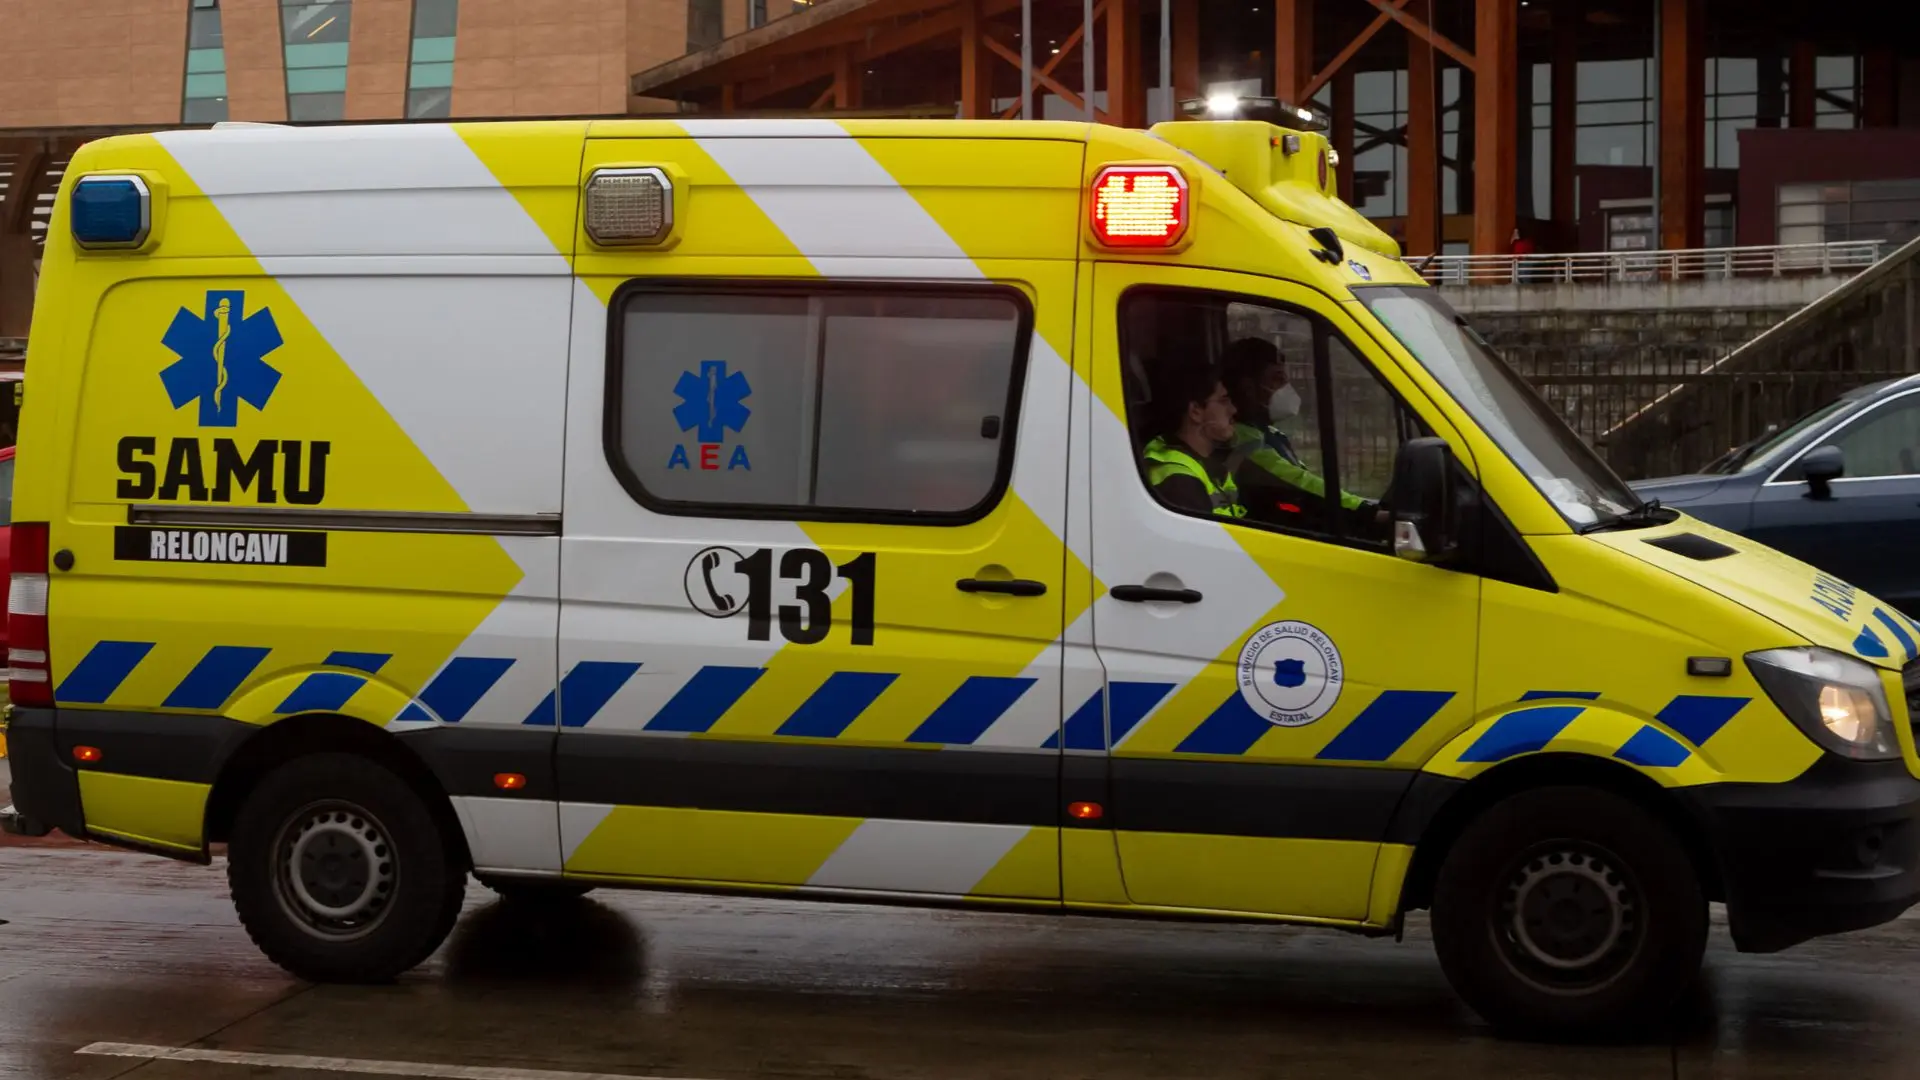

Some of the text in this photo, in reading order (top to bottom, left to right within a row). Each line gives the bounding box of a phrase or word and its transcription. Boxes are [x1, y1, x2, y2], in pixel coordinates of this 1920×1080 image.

[116, 436, 331, 505] SAMU
[150, 530, 288, 564] RELONCAVI
[734, 548, 877, 646] 131
[1243, 627, 1339, 686] SERVICIO DE SALUD RELONCAVI
[1270, 711, 1313, 722] ESTATAL
